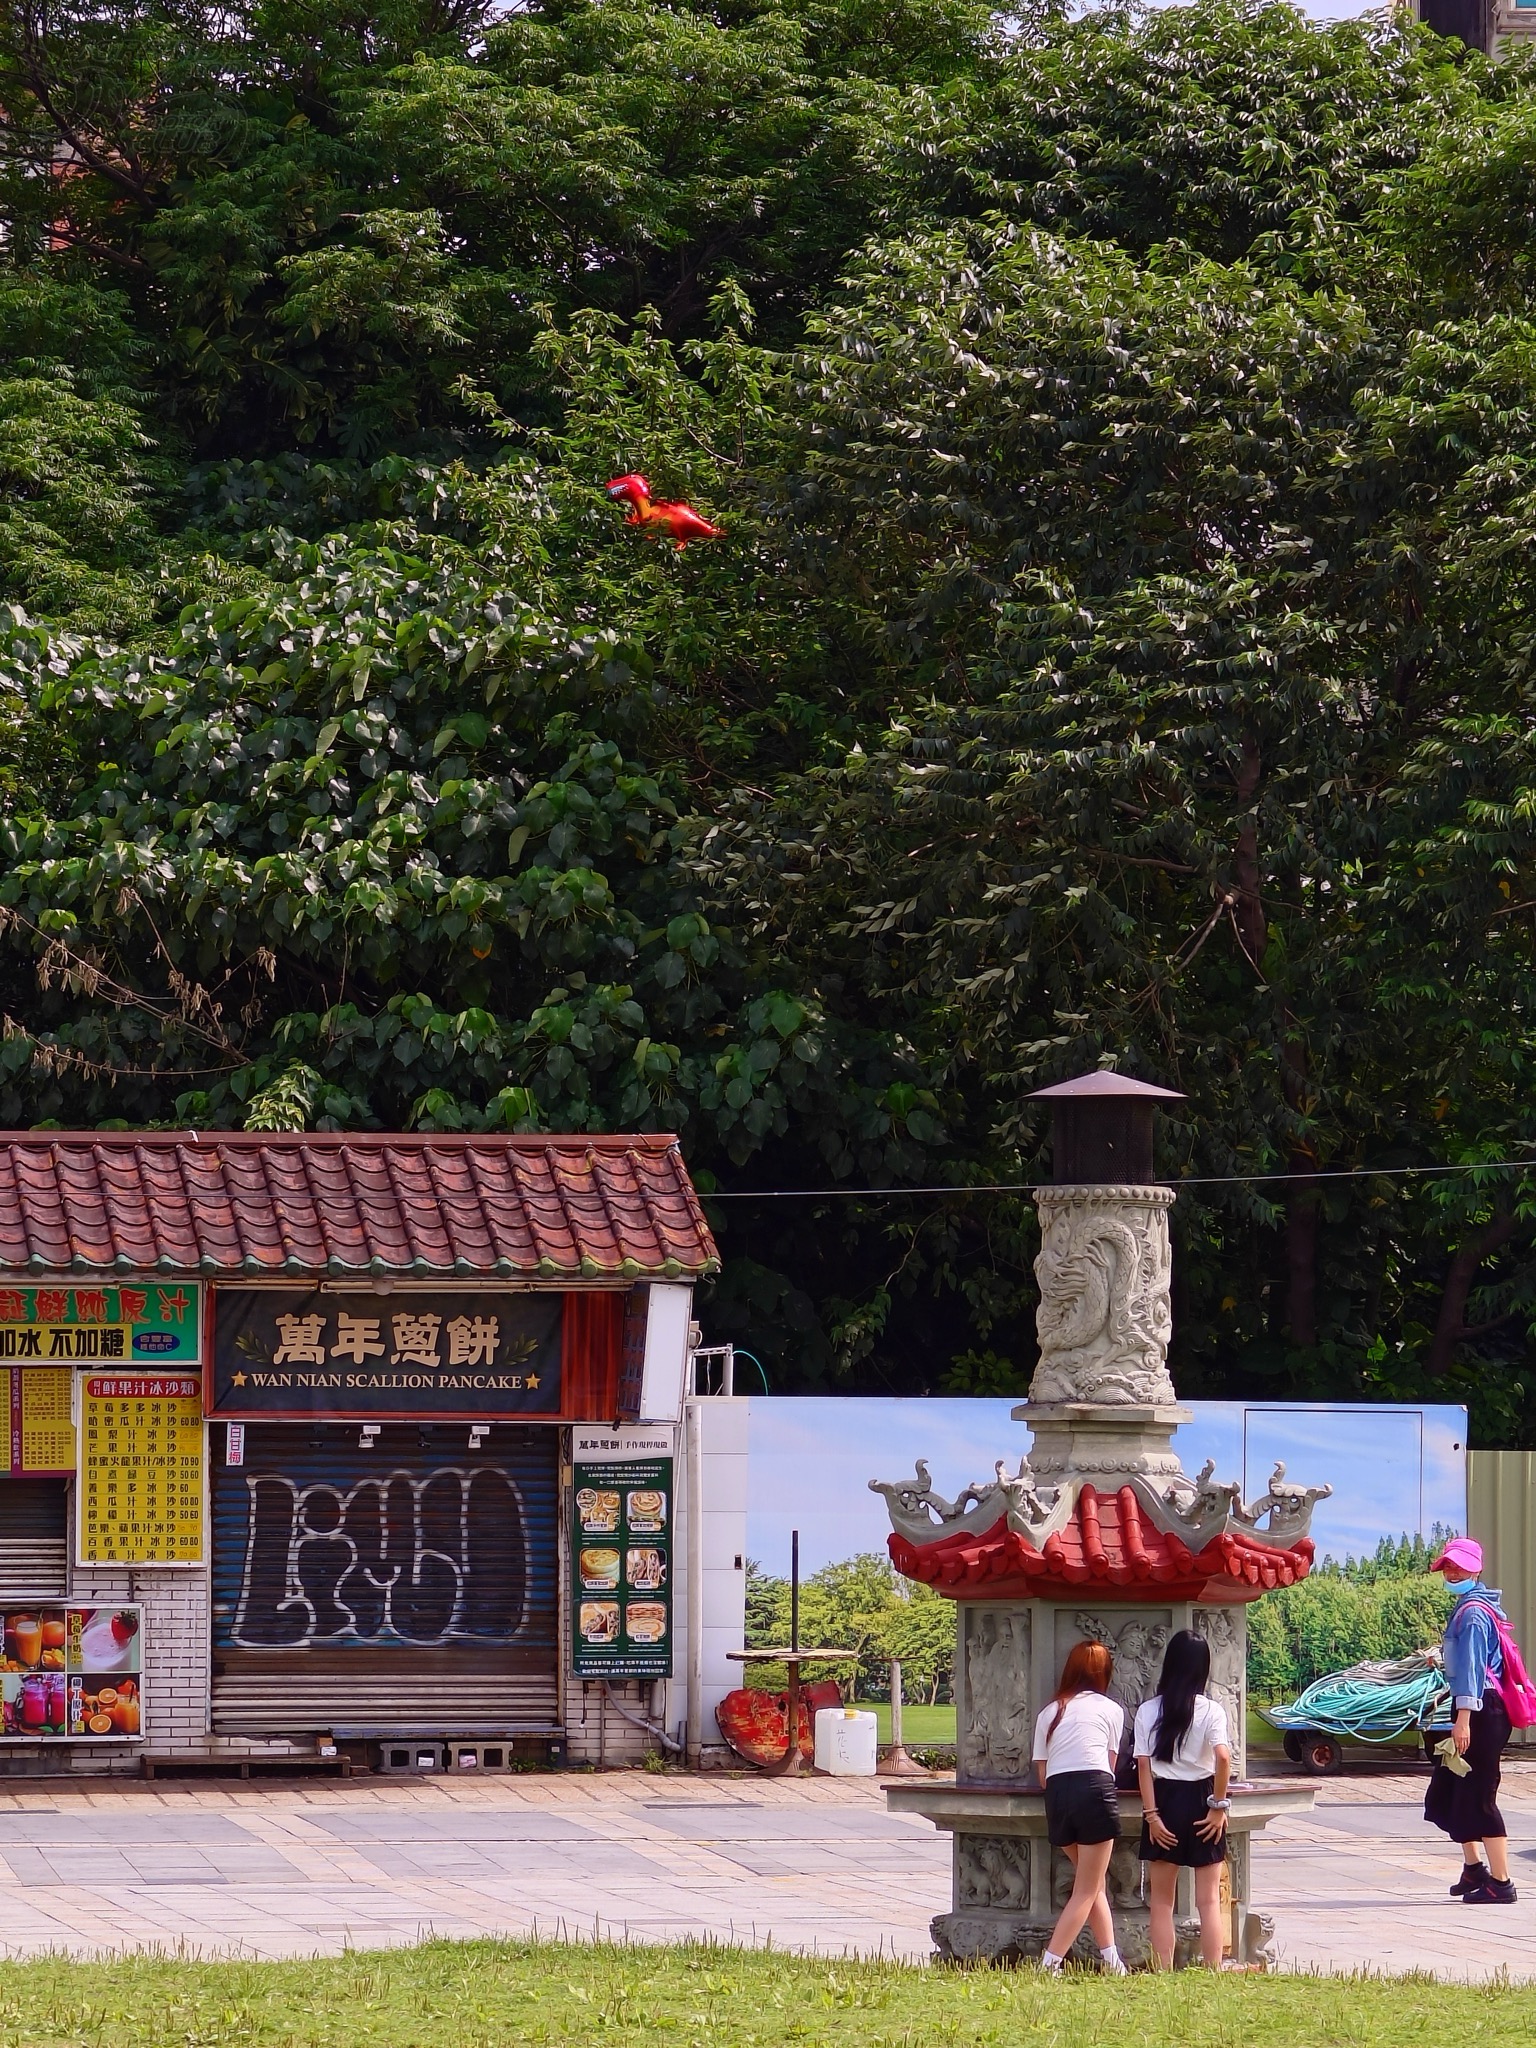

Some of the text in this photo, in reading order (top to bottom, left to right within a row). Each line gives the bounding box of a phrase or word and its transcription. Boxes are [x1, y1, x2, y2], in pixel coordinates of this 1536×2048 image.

[49, 1328, 124, 1357] 不加糖
[272, 1312, 500, 1368] 萬年蔥餅
[251, 1373, 522, 1389] WAN NIAN SCALLION PANCAKE
[102, 1380, 195, 1396] 鮮果汁冰沙類
[88, 1402, 177, 1413] 草莓多多冰沙
[88, 1416, 199, 1426] 哈密瓜汁冰沙 60 80
[88, 1443, 177, 1453] 芒果汁冰沙
[180, 1457, 189, 1466] 70
[190, 1457, 199, 1466] 90
[180, 1470, 188, 1479] 50
[190, 1470, 199, 1479] 60
[180, 1483, 188, 1492] 60
[88, 1496, 177, 1506] 西瓜汁冰沙
[180, 1497, 188, 1506] 60
[180, 1510, 188, 1519] 50
[88, 1536, 177, 1547] 百香果汁冰沙
[88, 1550, 177, 1560] 香蕉汁冰沙
